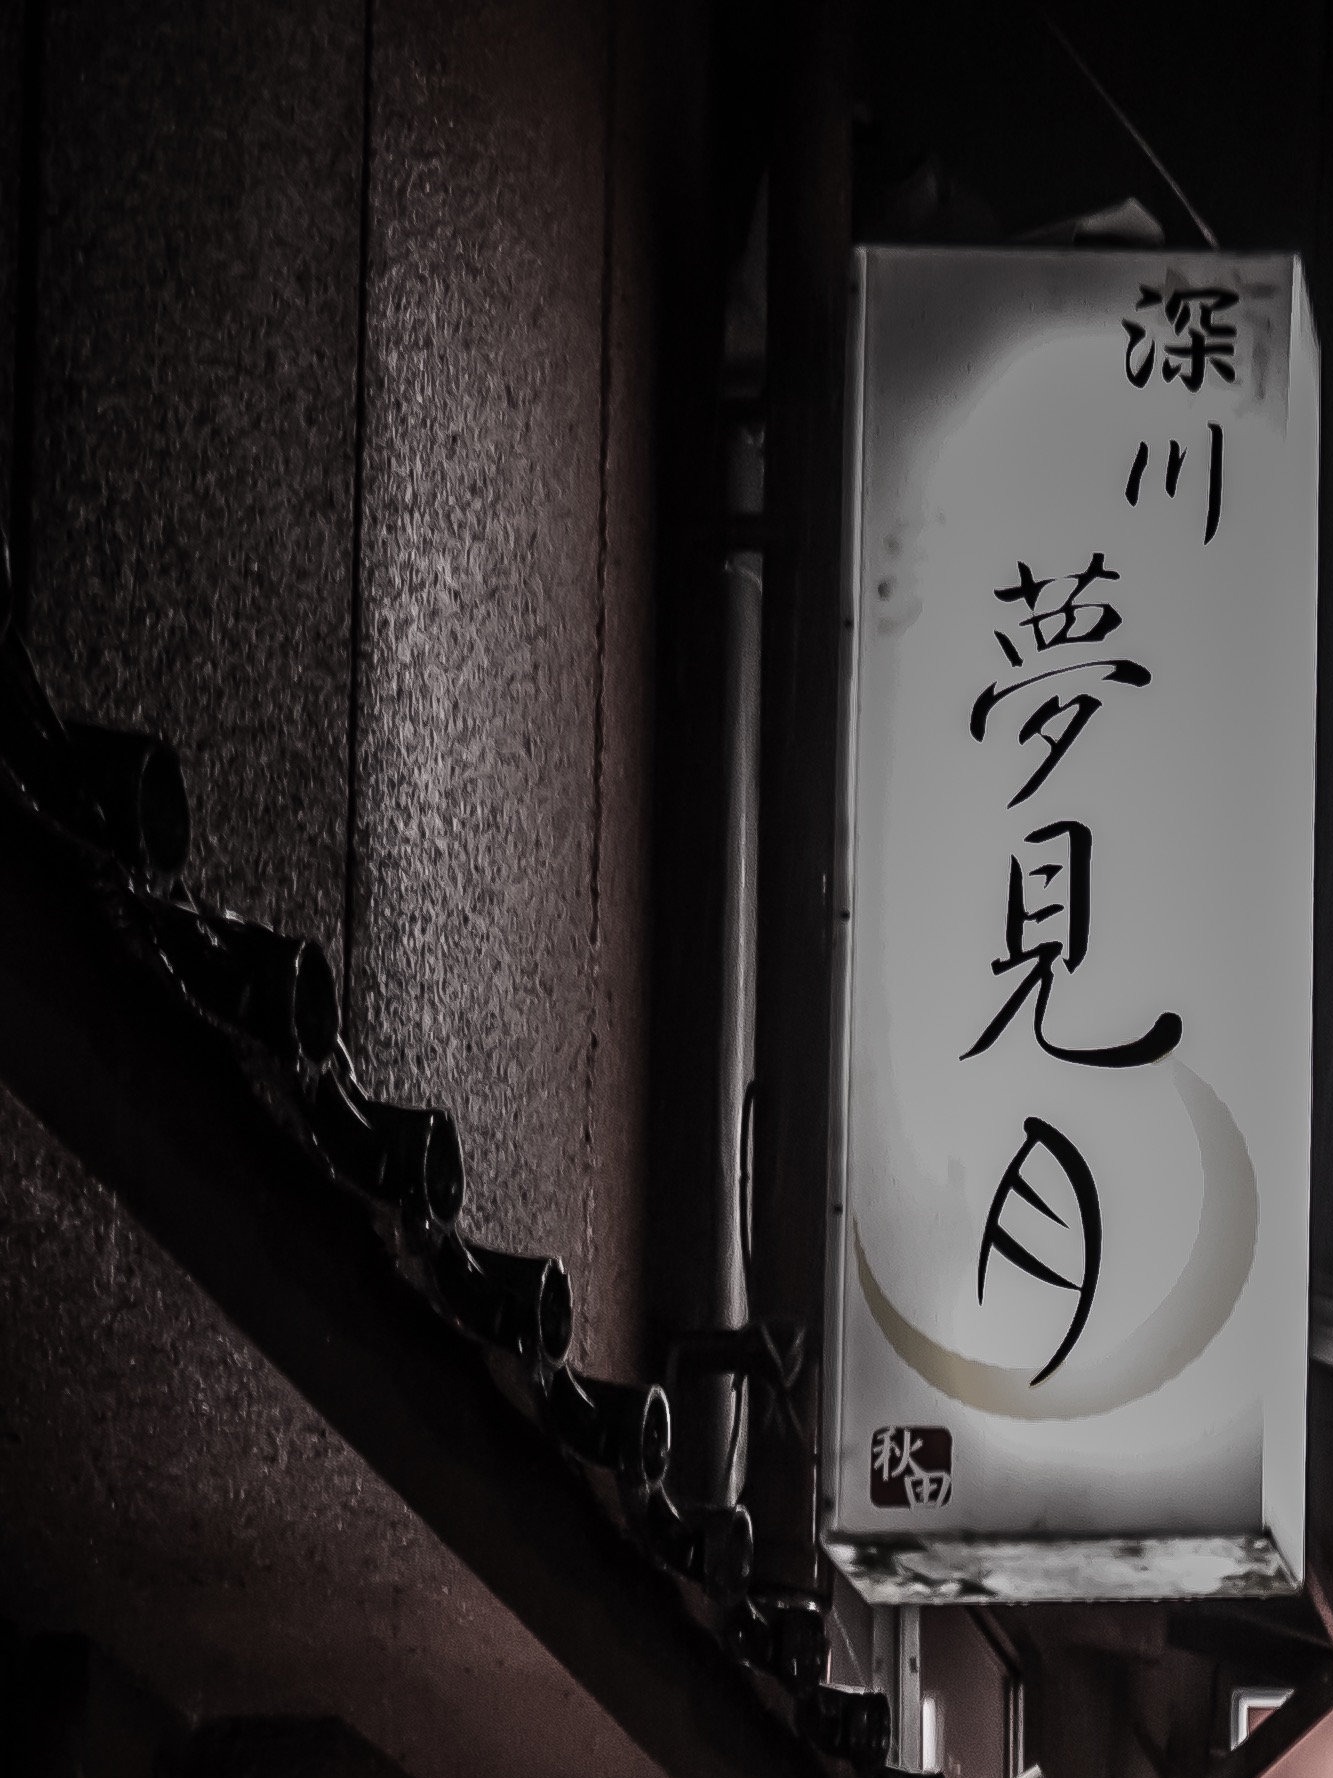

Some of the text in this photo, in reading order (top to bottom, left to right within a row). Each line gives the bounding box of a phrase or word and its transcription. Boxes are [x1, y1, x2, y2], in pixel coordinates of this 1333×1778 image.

[1122, 283, 1239, 546] 深川
[961, 553, 1183, 1387] 夢見月
